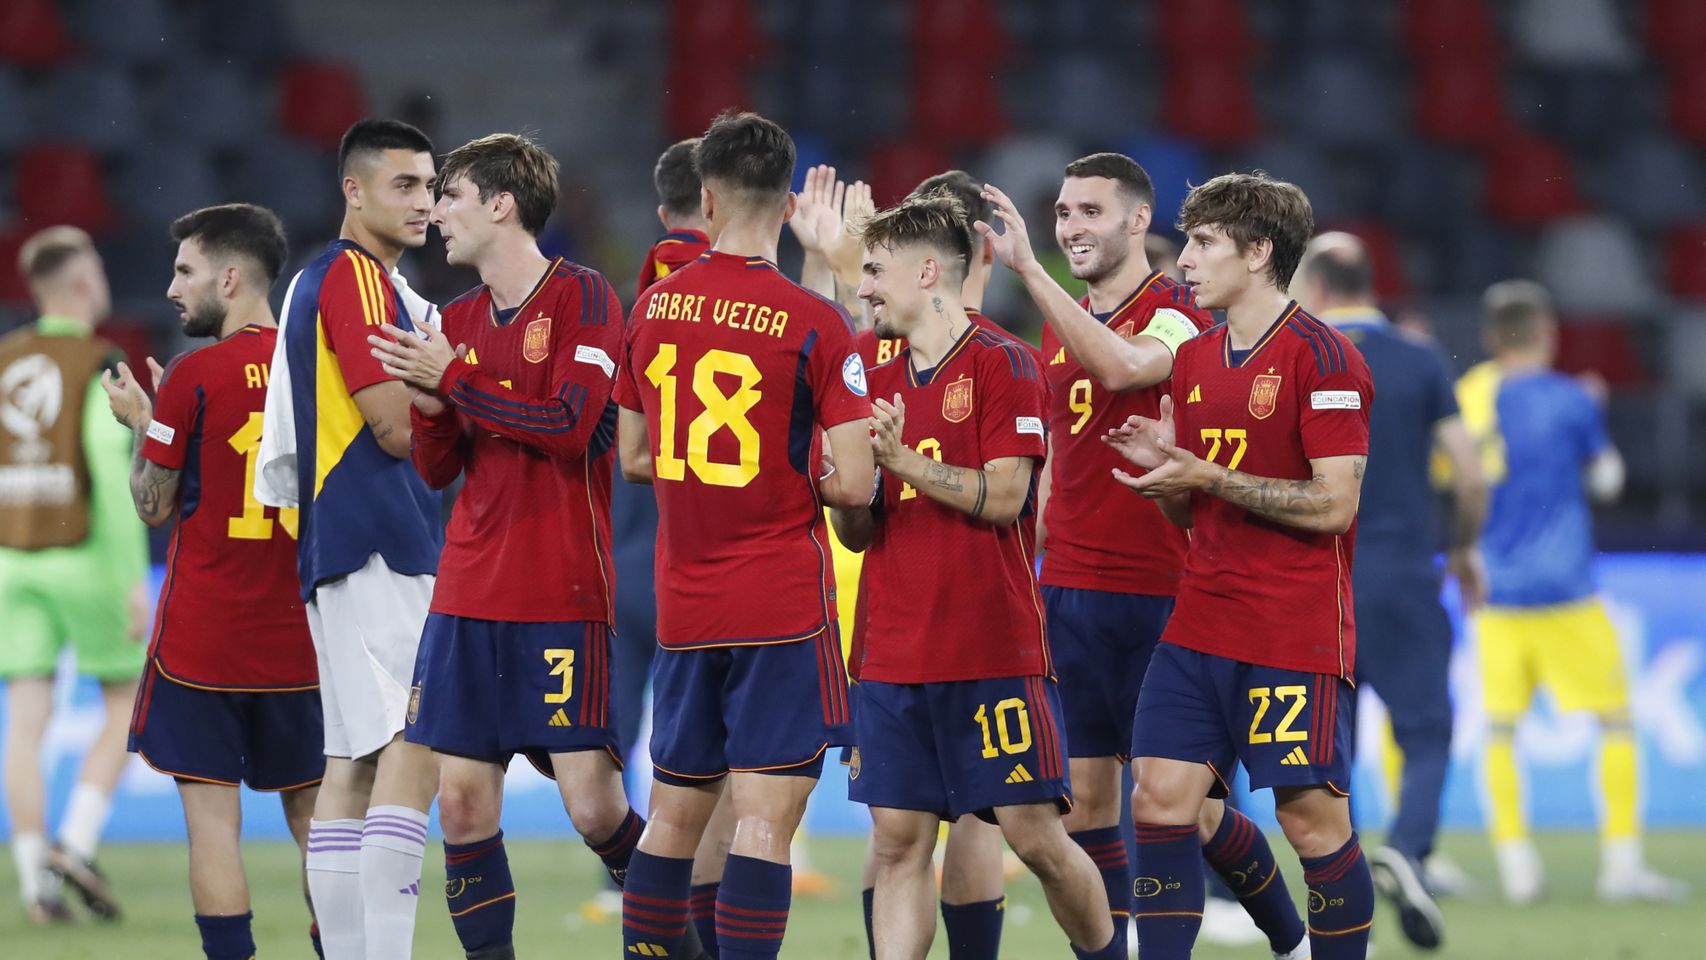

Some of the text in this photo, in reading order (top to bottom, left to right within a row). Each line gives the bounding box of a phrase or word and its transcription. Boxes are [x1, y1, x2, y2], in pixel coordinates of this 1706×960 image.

[646, 292, 789, 338] GABRI VEIGA
[644, 343, 763, 488] 18
[1068, 379, 1093, 435] 9
[1312, 396, 1360, 404] FOUNDATION
[543, 649, 575, 704] 3
[973, 697, 1033, 760] 10
[1249, 685, 1308, 745] 22
